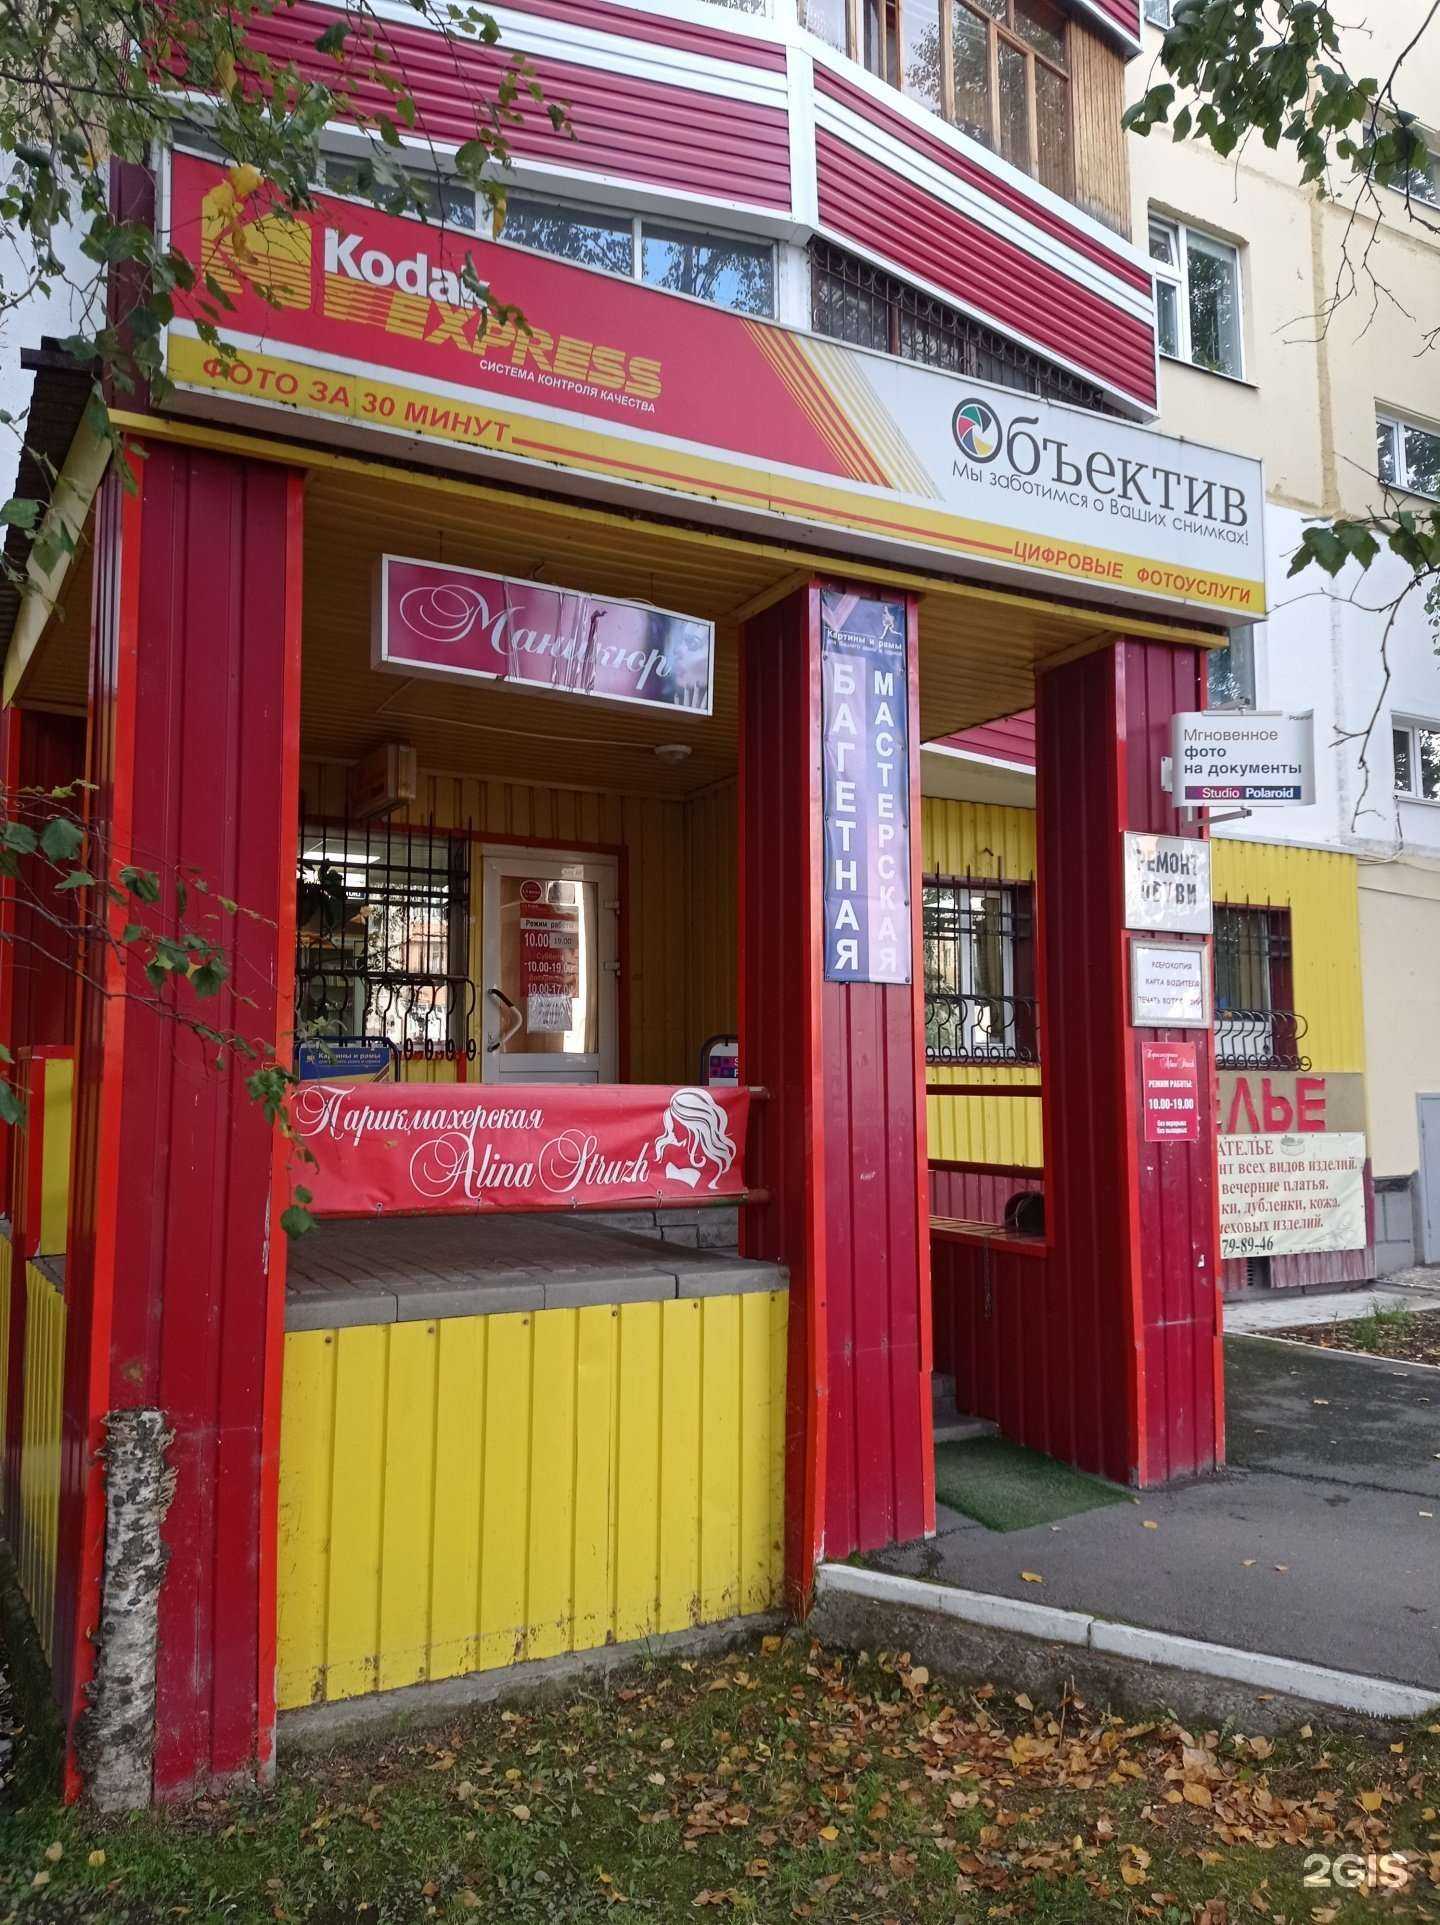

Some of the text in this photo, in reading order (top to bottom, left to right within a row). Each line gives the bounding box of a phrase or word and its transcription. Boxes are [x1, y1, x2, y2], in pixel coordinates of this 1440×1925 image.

[385, 290, 662, 400] EXPRESS
[308, 380, 350, 408] ЗА
[362, 392, 396, 418] 30
[404, 402, 511, 443] МИНУТ
[479, 359, 656, 413] СИСТЕМА КОНТРОЛЯ КАЧЕСТВА
[951, 397, 1249, 528] Объектив
[952, 460, 1249, 546] Мы заботимся о Ваших снимках!
[1013, 541, 1251, 605] ЦИФРОВЫЕ ФОТОУСЛУГИ
[1184, 729, 1279, 742] Мгновенное
[1184, 746, 1227, 760] фото
[1184, 763, 1302, 777] на документы
[1202, 787, 1294, 799] Studio Polaroid
[832, 663, 860, 970] БАГЕТНАЯ
[874, 670, 897, 973] МАСТЕРСКАЯ
[524, 932, 549, 947] 10.00
[296, 1085, 545, 1146] Парикмахерская
[1217, 1077, 1326, 1134] ЛЬЕ
[410, 1128, 649, 1198] Alina Struzh
[1221, 1181, 1281, 1198] вечерние
[1238, 1162, 1265, 1175] всех
[1269, 1160, 1306, 1173] видов
